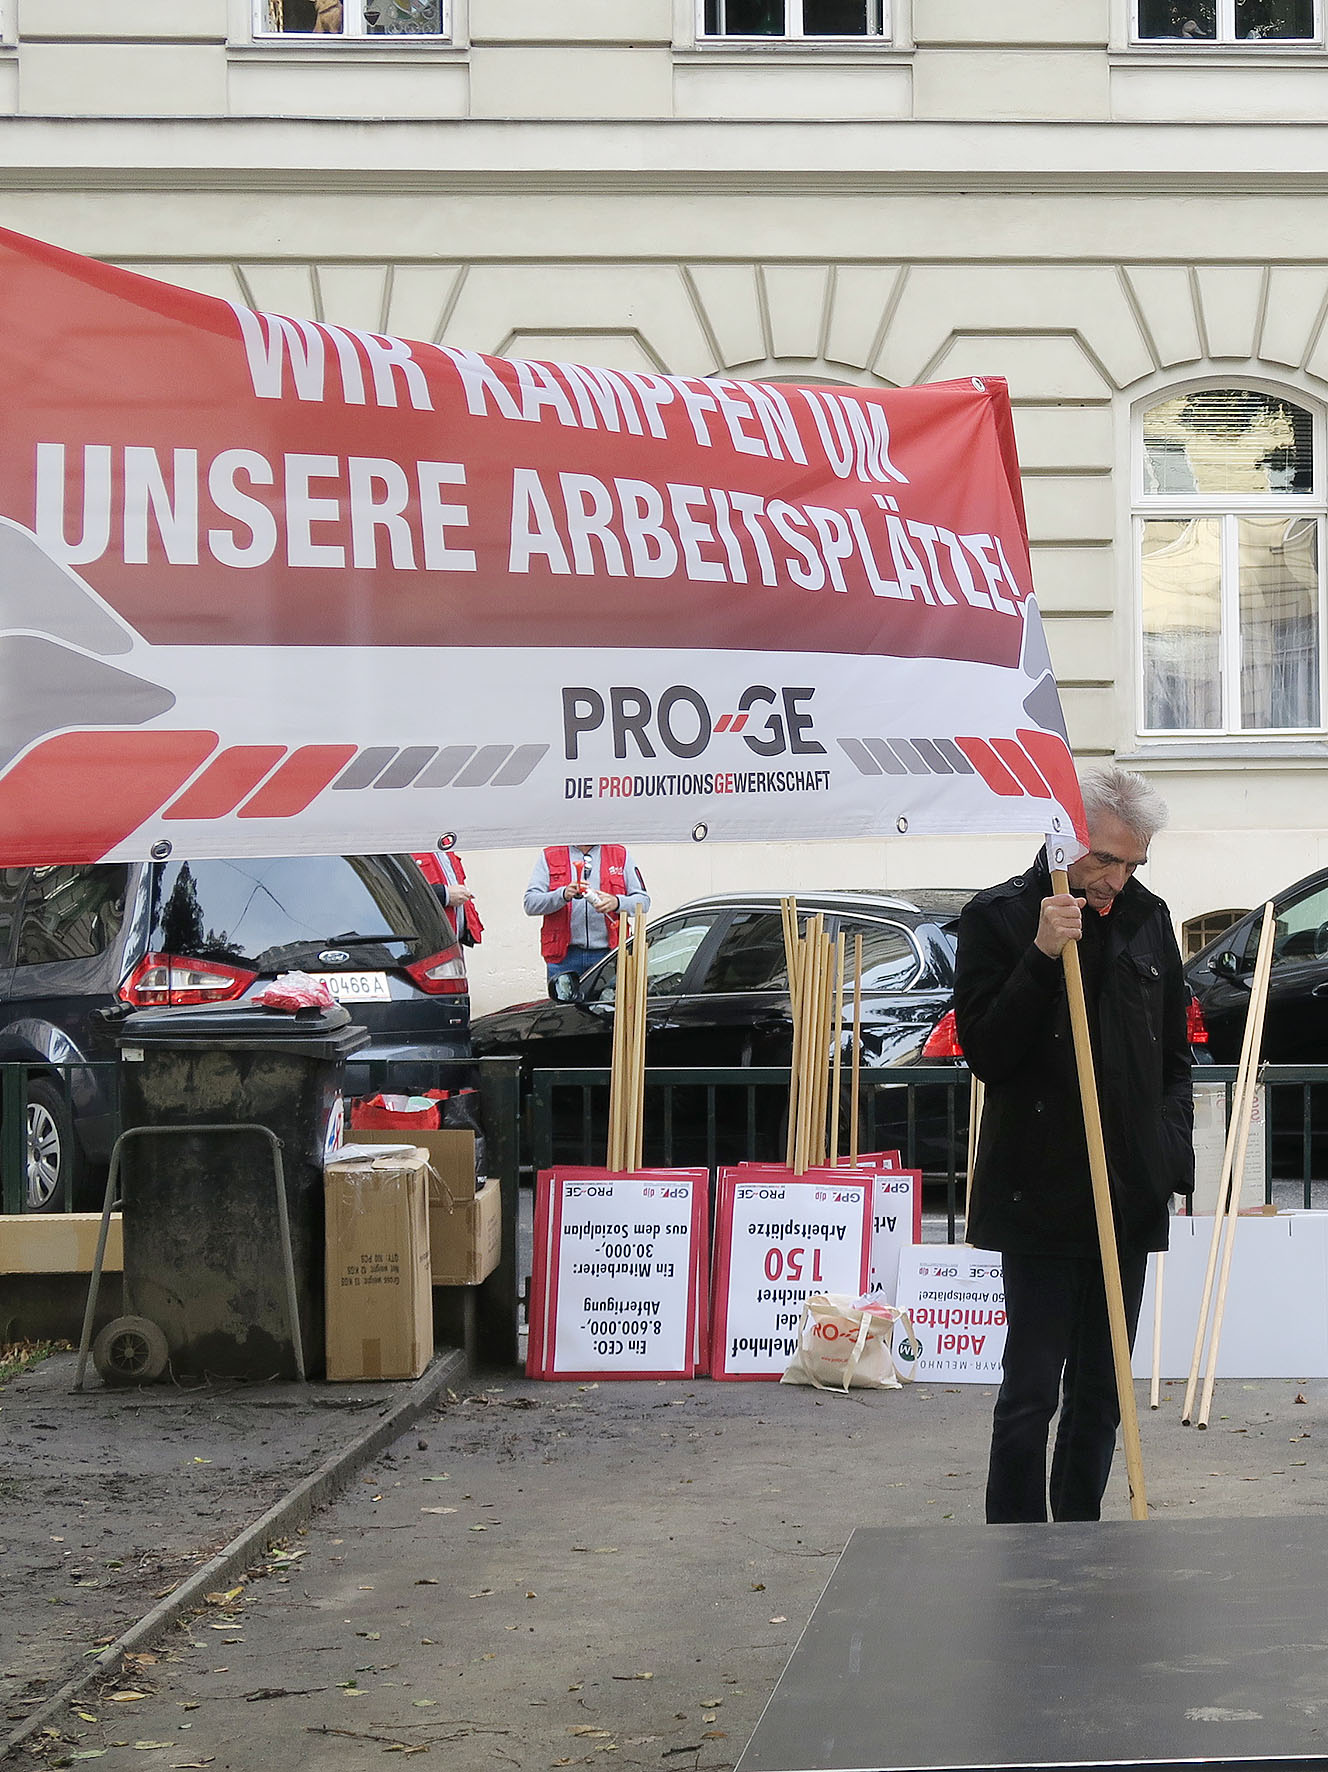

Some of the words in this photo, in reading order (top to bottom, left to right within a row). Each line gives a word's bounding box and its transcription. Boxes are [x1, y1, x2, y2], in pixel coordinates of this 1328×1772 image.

[228, 299, 434, 411] WIR
[797, 388, 910, 484] UM
[34, 441, 477, 574] UNSERE
[507, 467, 1026, 618] ARBEITSPLÄTZE!
[564, 777, 594, 800] DIE
[598, 770, 832, 798] PRODUKTIONSGEWERKSCHAFT
[563, 1221, 629, 1239] Sozialplan
[634, 1224, 660, 1239] dem
[666, 1224, 688, 1237] aus
[748, 1220, 847, 1241] Arbeitsplätze
[595, 1242, 654, 1258] 30.000,-
[573, 1263, 651, 1277] Mitarbeiter:
[656, 1263, 674, 1277] Ein
[764, 1247, 823, 1282] 150
[969, 1268, 1004, 1278] RO-GE
[919, 1290, 990, 1302] Arbeitsplätze!
[992, 1292, 1005, 1302] 50
[583, 1297, 660, 1316] Abfertigung
[580, 1319, 662, 1335] 8.600.000,-
[776, 1314, 802, 1330] del
[908, 1308, 1008, 1330] ernichtet
[593, 1340, 623, 1354] CEO:
[628, 1340, 646, 1354] Ein
[937, 1334, 986, 1355] Adel
